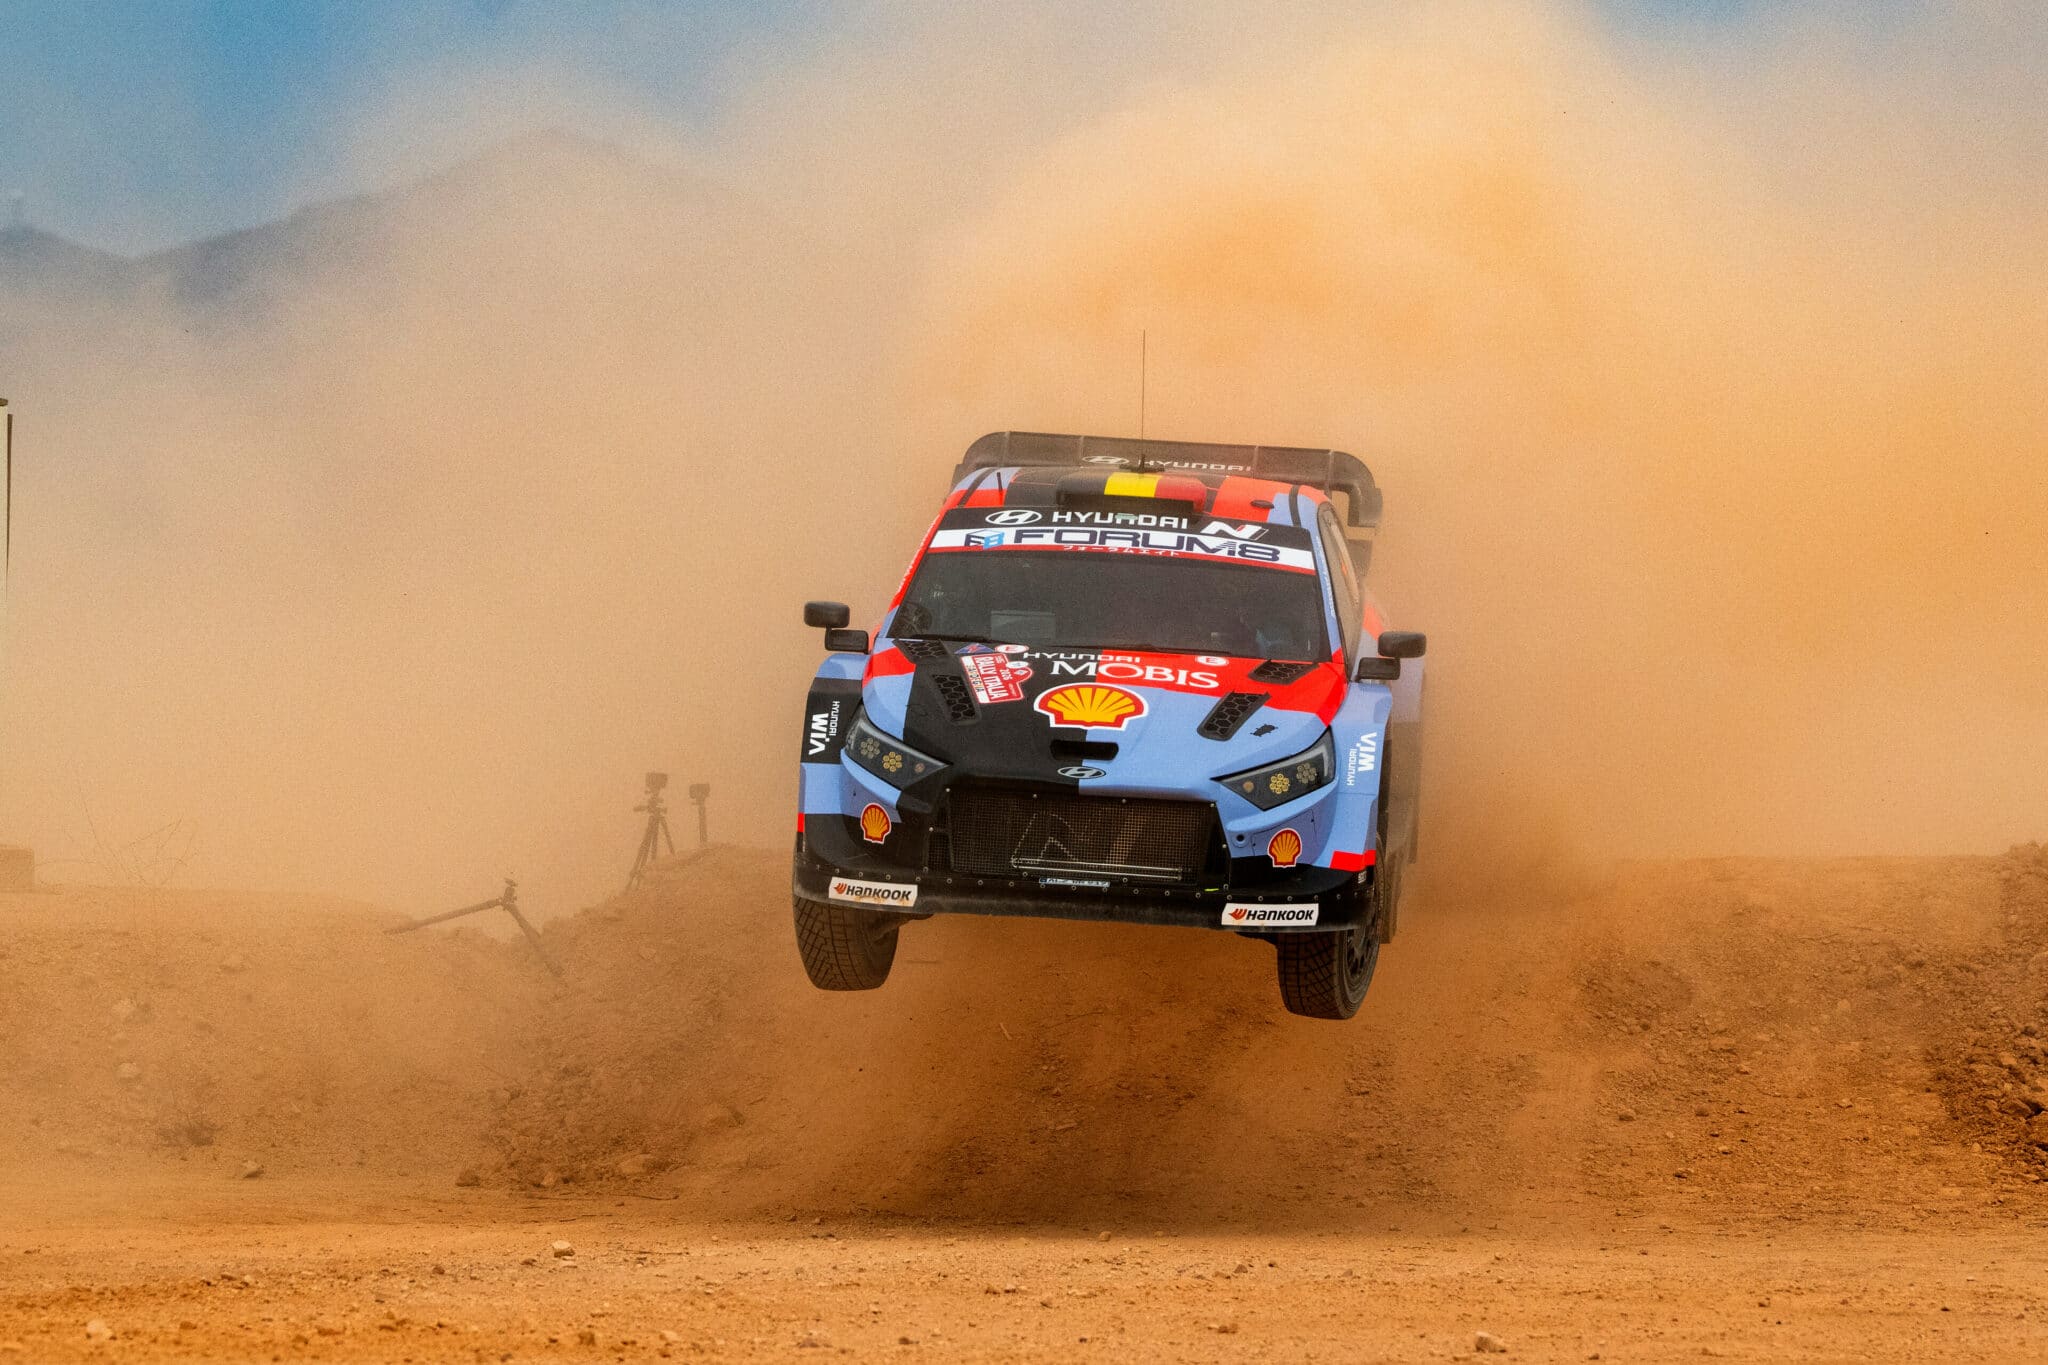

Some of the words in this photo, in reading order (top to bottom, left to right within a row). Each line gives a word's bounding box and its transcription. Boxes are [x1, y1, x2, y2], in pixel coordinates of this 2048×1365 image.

[1138, 459, 1252, 472] HYUNDAI
[1052, 511, 1187, 529] HYUNDAI
[1014, 528, 1280, 562] FORUM8
[975, 656, 998, 675] RALLY
[1023, 652, 1140, 663] HYUNDAI
[1050, 660, 1219, 689] MOBIS
[983, 675, 1009, 699] ITALIA
[829, 700, 840, 736] HYUNDAI
[1346, 748, 1357, 786] HYUNDAI
